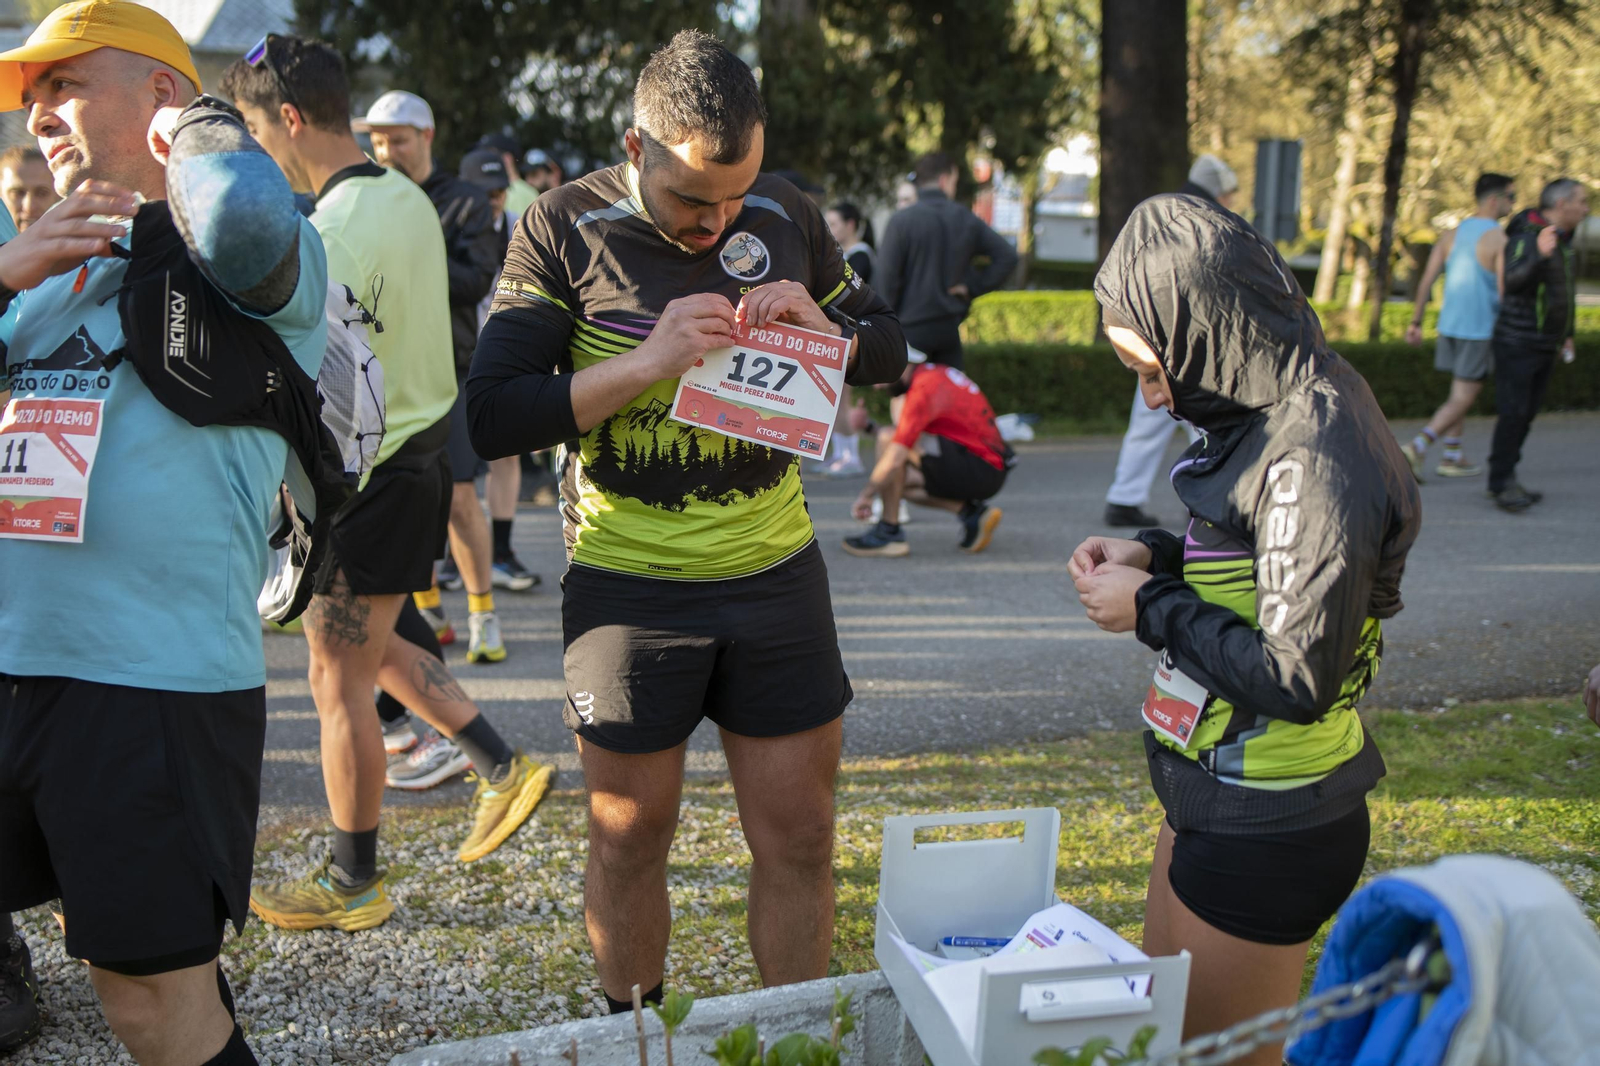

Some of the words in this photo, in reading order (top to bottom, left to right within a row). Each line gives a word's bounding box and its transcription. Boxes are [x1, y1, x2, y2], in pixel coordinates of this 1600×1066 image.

[748, 327, 783, 346] POZO
[785, 337, 804, 352] DO
[806, 342, 839, 361] DEMO
[40, 373, 59, 390] do
[727, 352, 798, 392] 127
[719, 380, 743, 394] MIGUEL
[744, 386, 765, 399] PEREZ
[765, 392, 795, 406] BORRAJO
[54, 409, 93, 427] DEMO
[0, 438, 27, 473] 11
[24, 477, 55, 487] MEDEIROS
